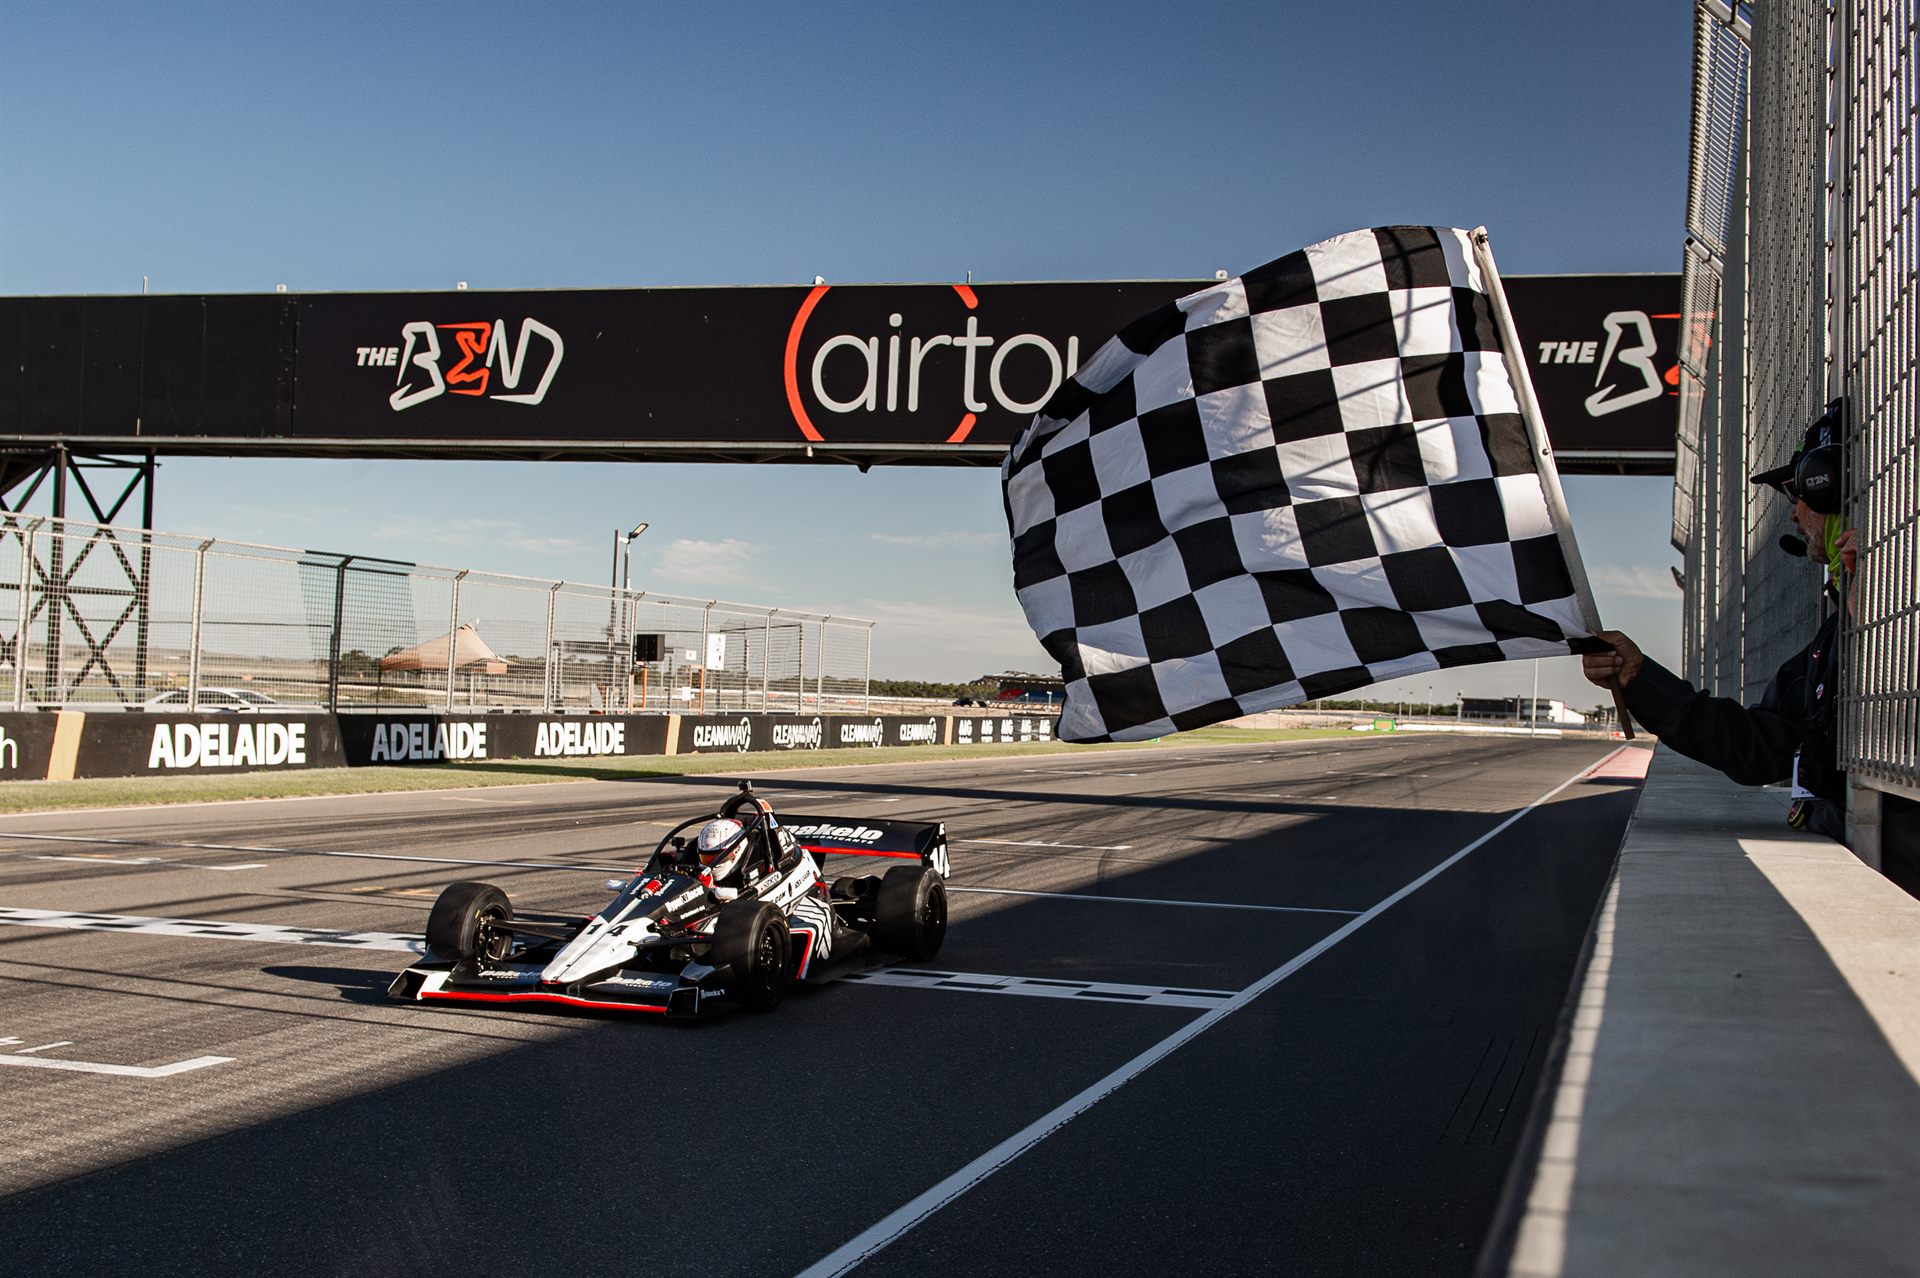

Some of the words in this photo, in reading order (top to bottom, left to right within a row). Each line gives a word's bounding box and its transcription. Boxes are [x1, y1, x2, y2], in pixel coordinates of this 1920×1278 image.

[1538, 341, 1598, 364] THE
[356, 347, 399, 367] THE
[389, 317, 564, 412] BEND
[371, 723, 487, 761] ADELAIDE
[534, 722, 625, 756] ADELAIDE
[693, 725, 748, 747] CLEANAWAY
[773, 725, 819, 745] CLEANAWAY
[841, 724, 881, 742] CLEANAWAY
[900, 724, 934, 741] CLEANAWAY
[148, 723, 306, 769] ADELAIDE
[586, 923, 630, 937] 14
